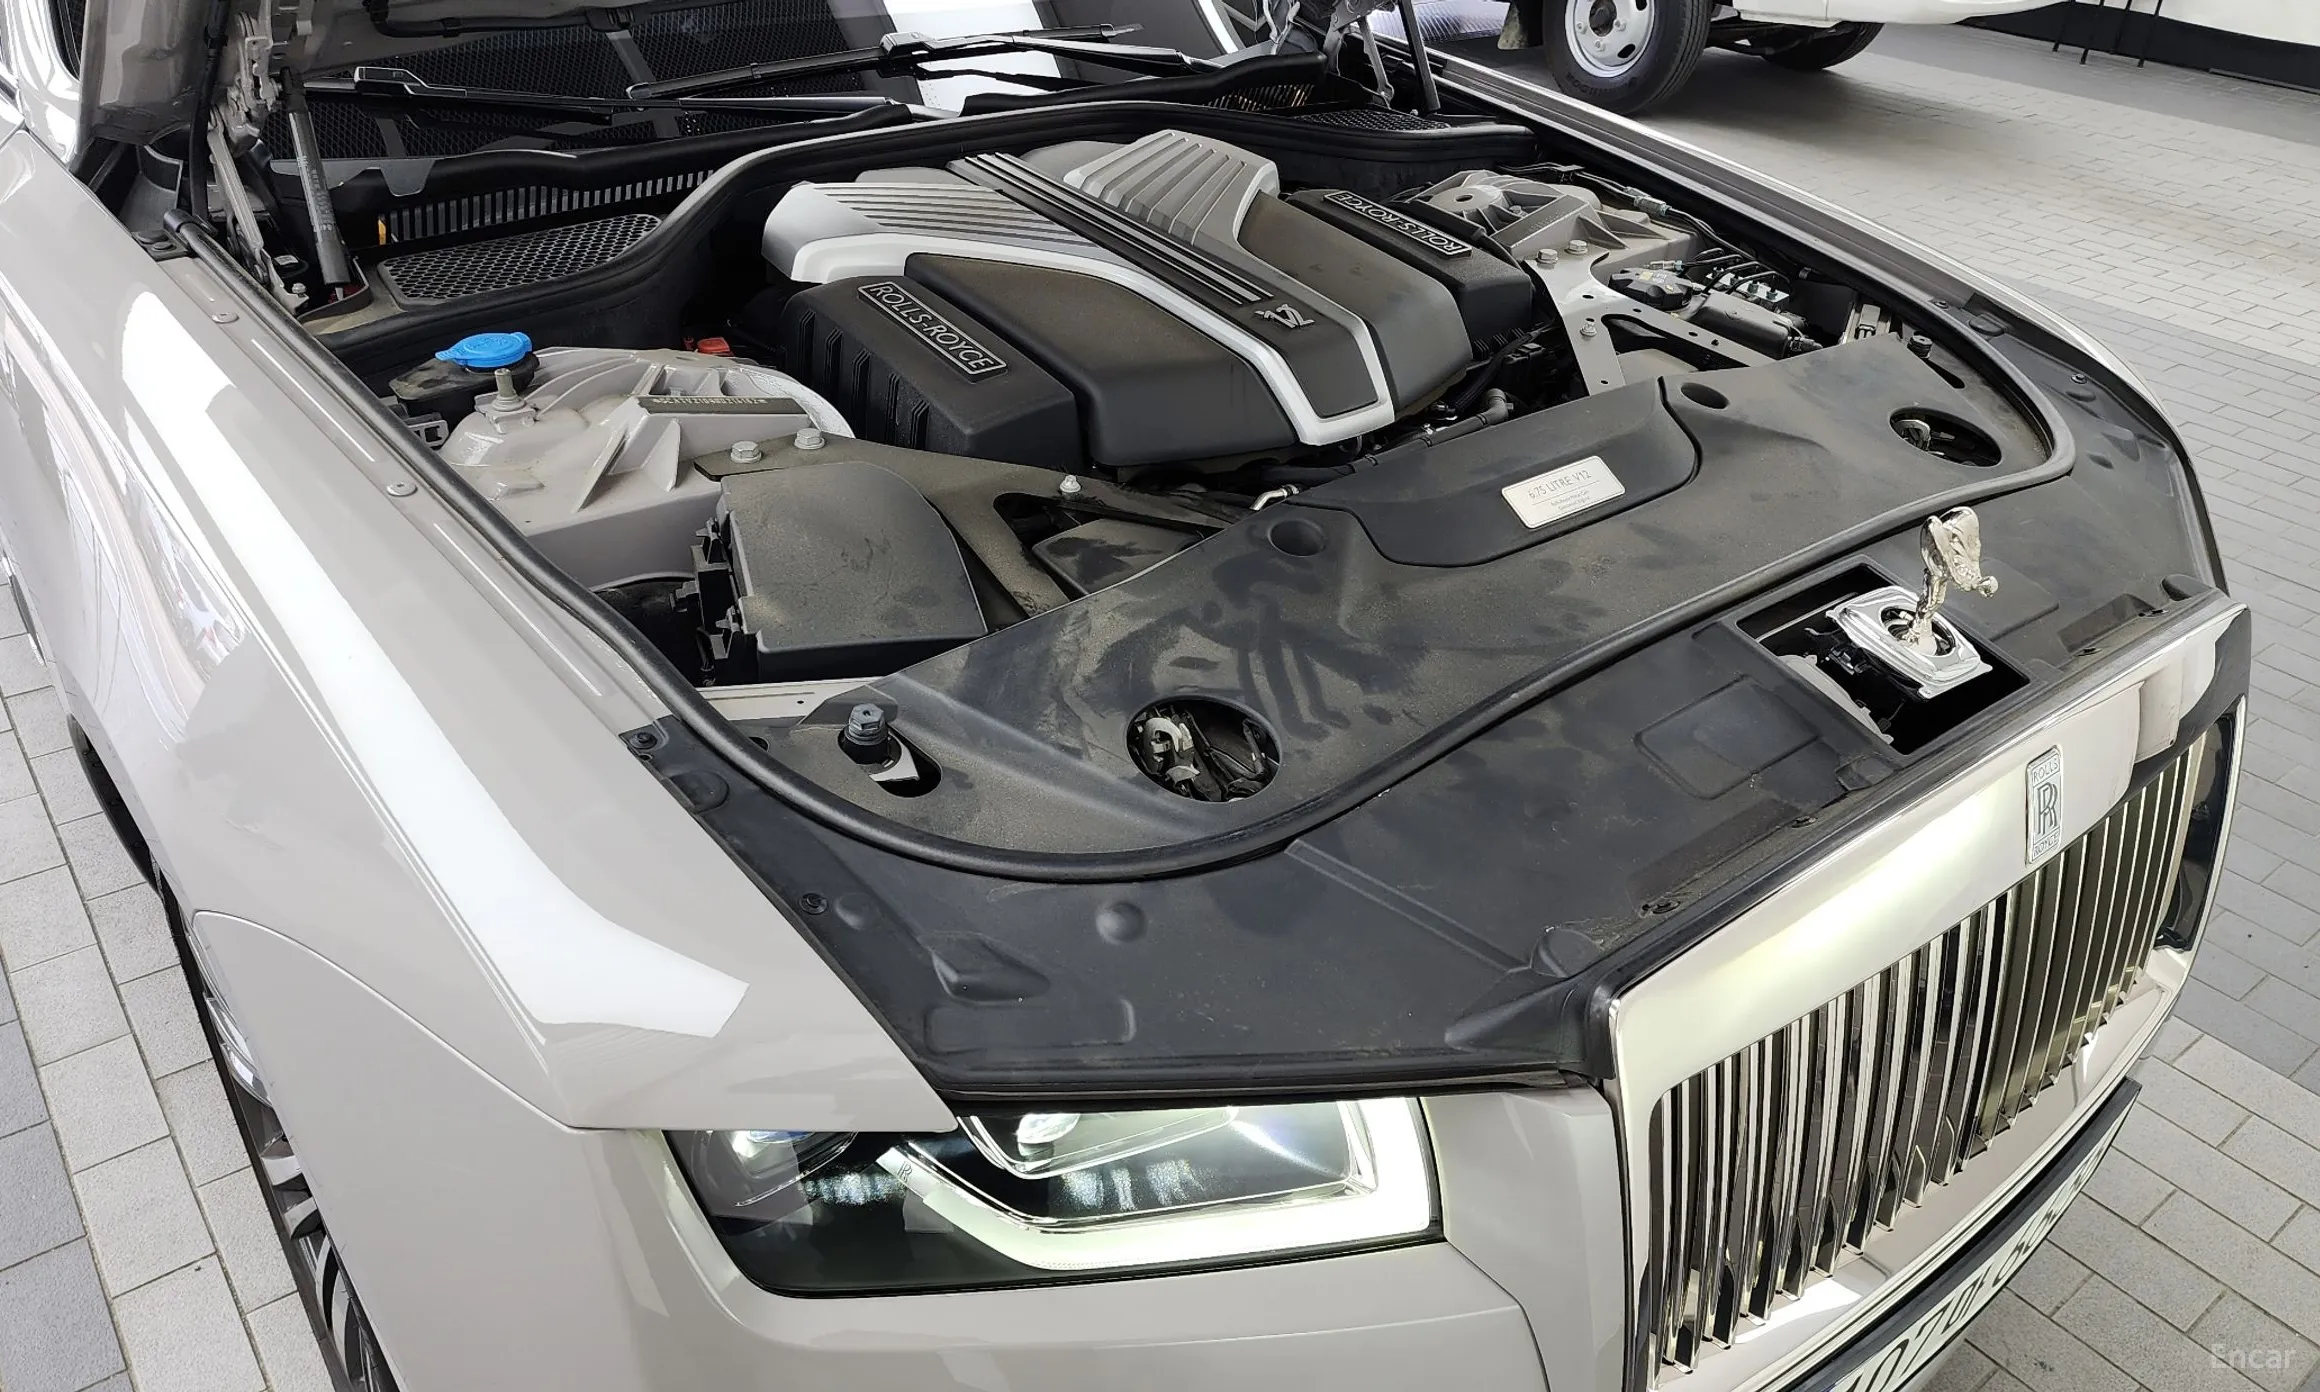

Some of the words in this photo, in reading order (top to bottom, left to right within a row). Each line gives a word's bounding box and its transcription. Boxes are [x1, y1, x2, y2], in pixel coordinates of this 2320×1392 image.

[1335, 192, 1462, 251] ROLLS-ROYCE
[870, 285, 994, 369] ROLLS-ROYCE
[1545, 475, 1574, 492] LITRE
[1571, 469, 1592, 481] V12
[2033, 757, 2060, 783] ROLLS
[2033, 830, 2060, 857] ROYCE
